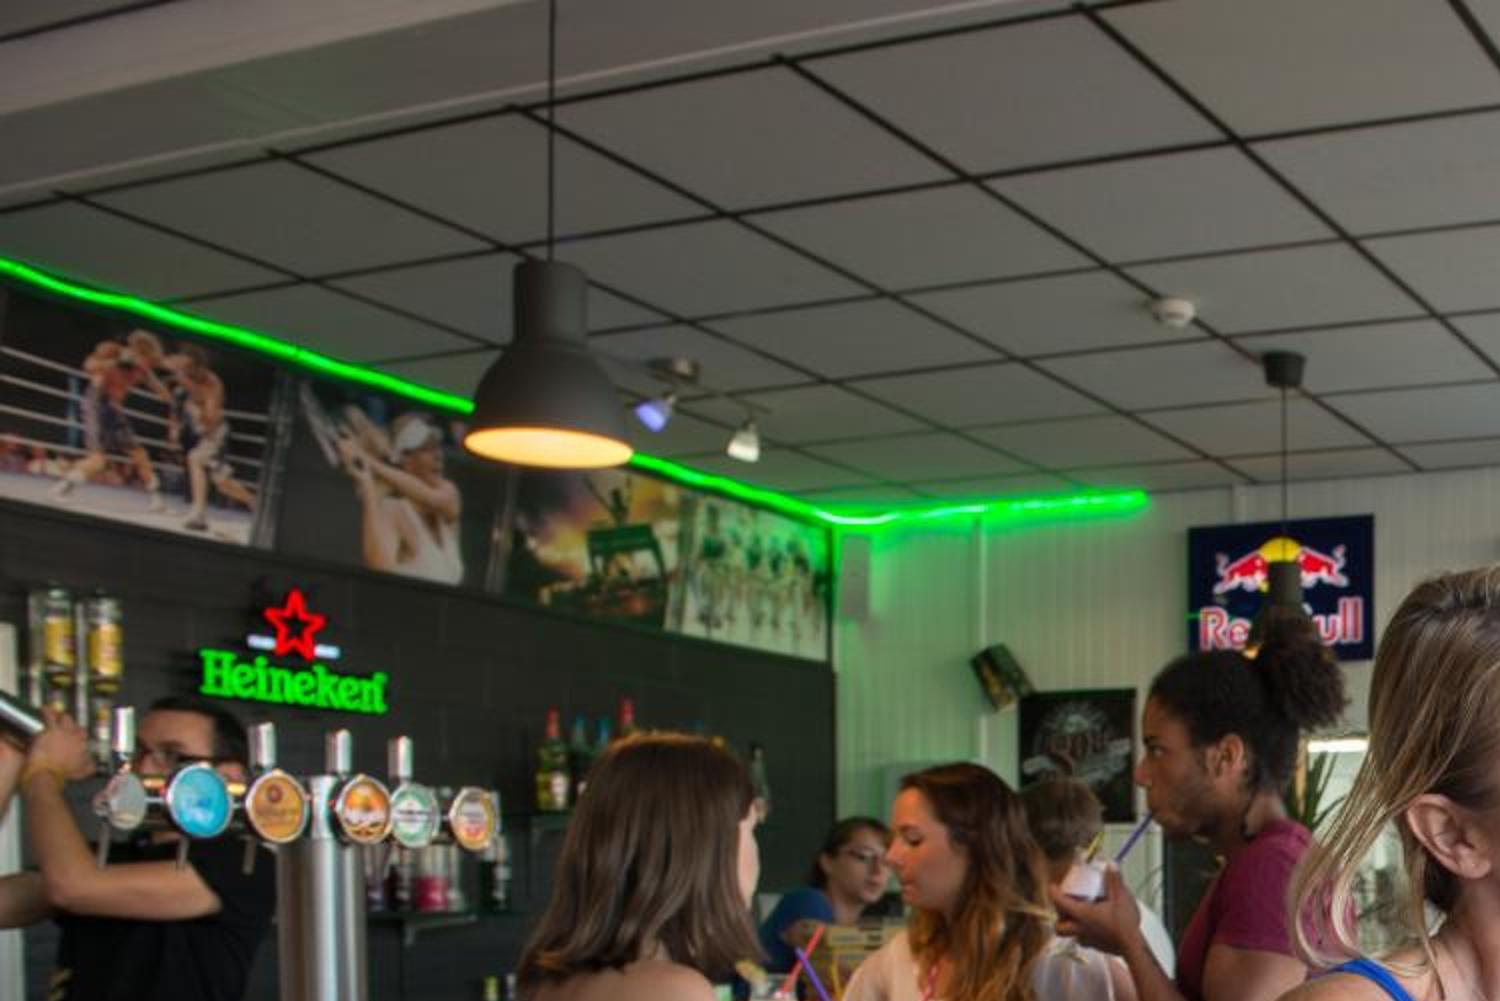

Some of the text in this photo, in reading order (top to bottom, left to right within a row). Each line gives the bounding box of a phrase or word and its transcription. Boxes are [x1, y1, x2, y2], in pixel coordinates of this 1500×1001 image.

[1200, 597, 1364, 650] Re ull
[200, 649, 389, 714] Heineken
